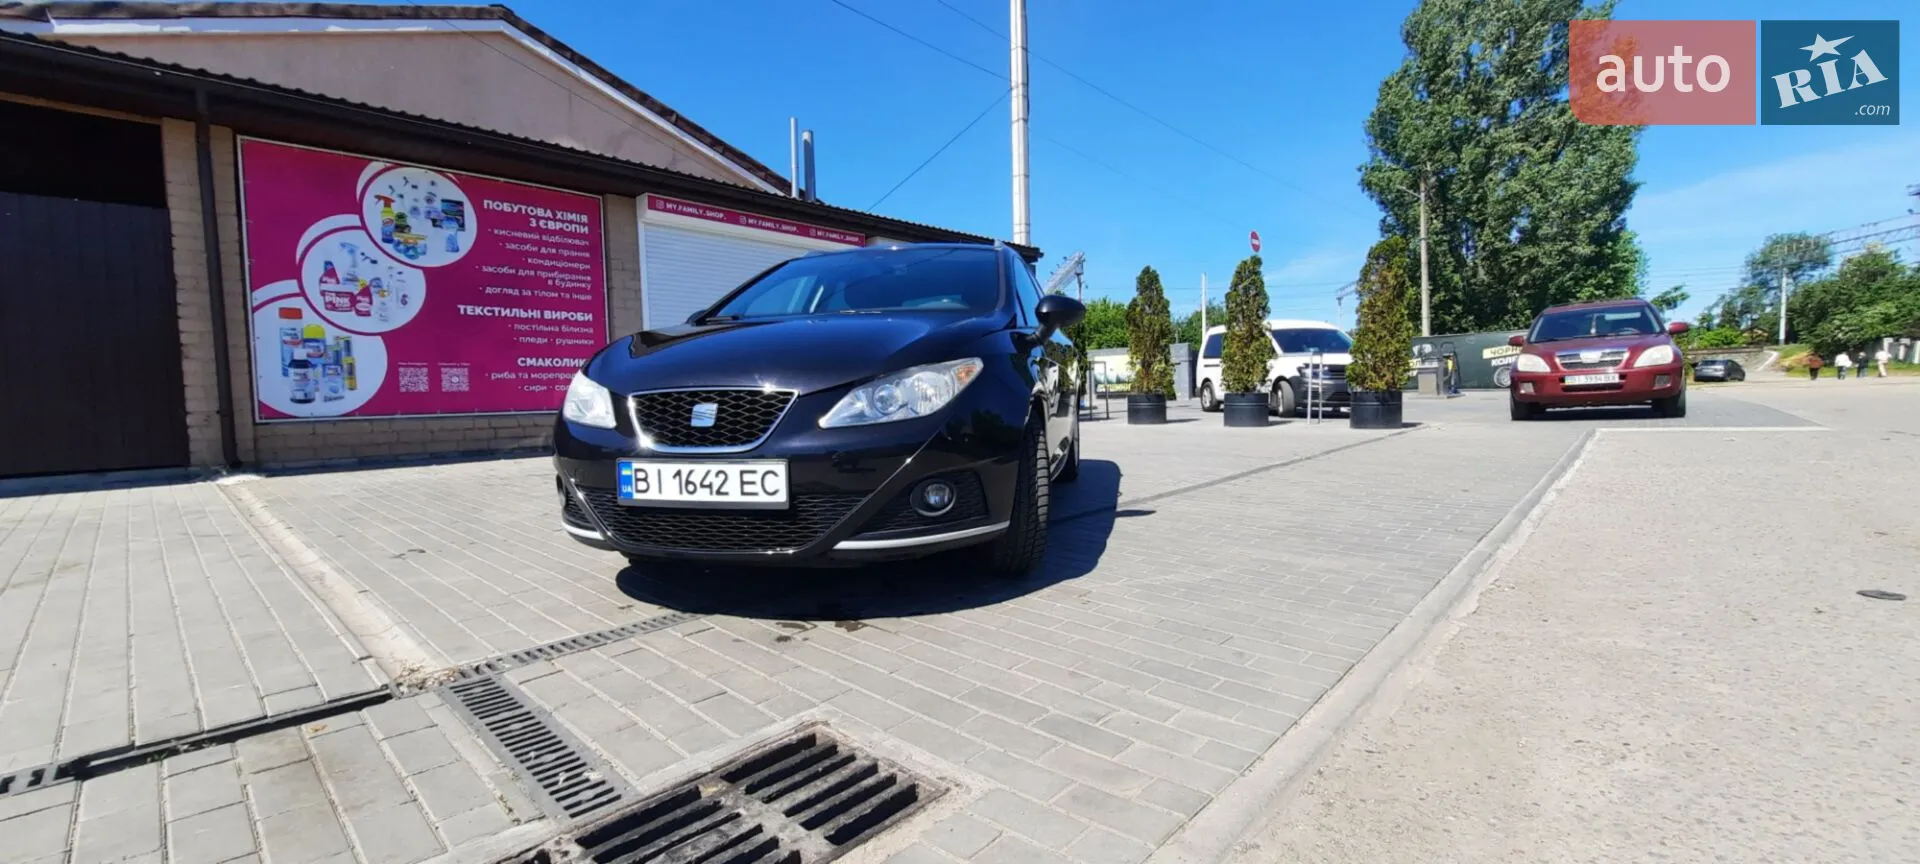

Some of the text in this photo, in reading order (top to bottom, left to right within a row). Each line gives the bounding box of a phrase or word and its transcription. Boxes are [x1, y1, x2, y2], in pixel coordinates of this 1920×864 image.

[483, 199, 589, 224] ПОБУТОВА ХІМІЯ
[539, 219, 589, 234] ЄВРОПИ
[493, 229, 589, 246] кисневий відбілювач
[505, 242, 591, 258] засоби для прання
[527, 258, 591, 270] кондиціонери
[481, 265, 592, 281] засоби для прибирання
[555, 279, 592, 291] будинку
[485, 286, 520, 296] догляд
[534, 289, 558, 298] тілом
[572, 292, 592, 301] інше
[457, 304, 593, 321] ТЕКСТИЛЬНІ ВИРОБИ
[514, 323, 594, 334] постільна білизна
[519, 336, 594, 346] пледи рушники
[517, 357, 588, 368] СМАКОЛИК
[491, 371, 516, 380] риба
[530, 372, 574, 381] морепрод
[523, 384, 547, 392] сири
[621, 484, 632, 493] UA
[634, 467, 780, 497] BI 1642 EC
